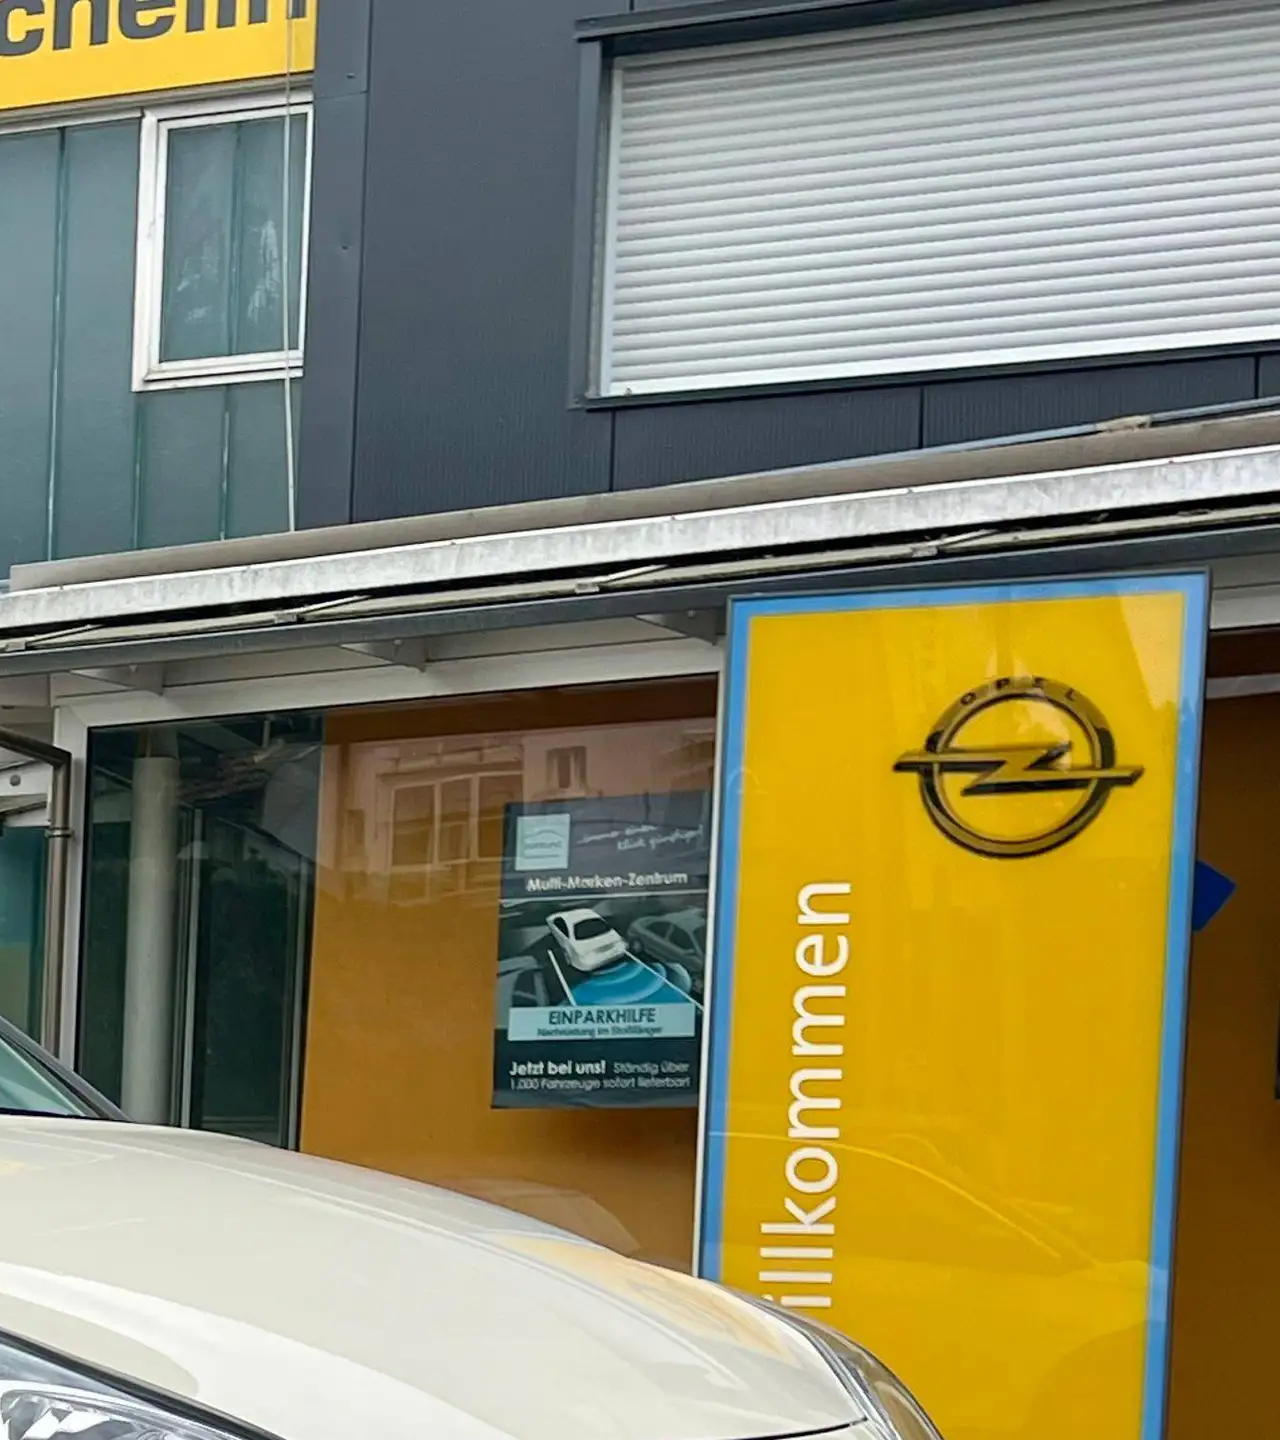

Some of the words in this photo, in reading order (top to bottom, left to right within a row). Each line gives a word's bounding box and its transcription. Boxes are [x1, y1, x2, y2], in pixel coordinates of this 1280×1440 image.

[960, 676, 1078, 706] OPEL
[526, 871, 688, 892] Multi-Marken-Zentrum
[548, 1008, 657, 1026] EINPARKHILFE
[509, 1060, 545, 1077] Jetzt
[547, 1059, 572, 1075] bei
[575, 1060, 607, 1075] uns!
[541, 1077, 601, 1091] Fahrzeuge
[603, 1076, 636, 1089] sofort
[758, 881, 851, 1308] illkommen
